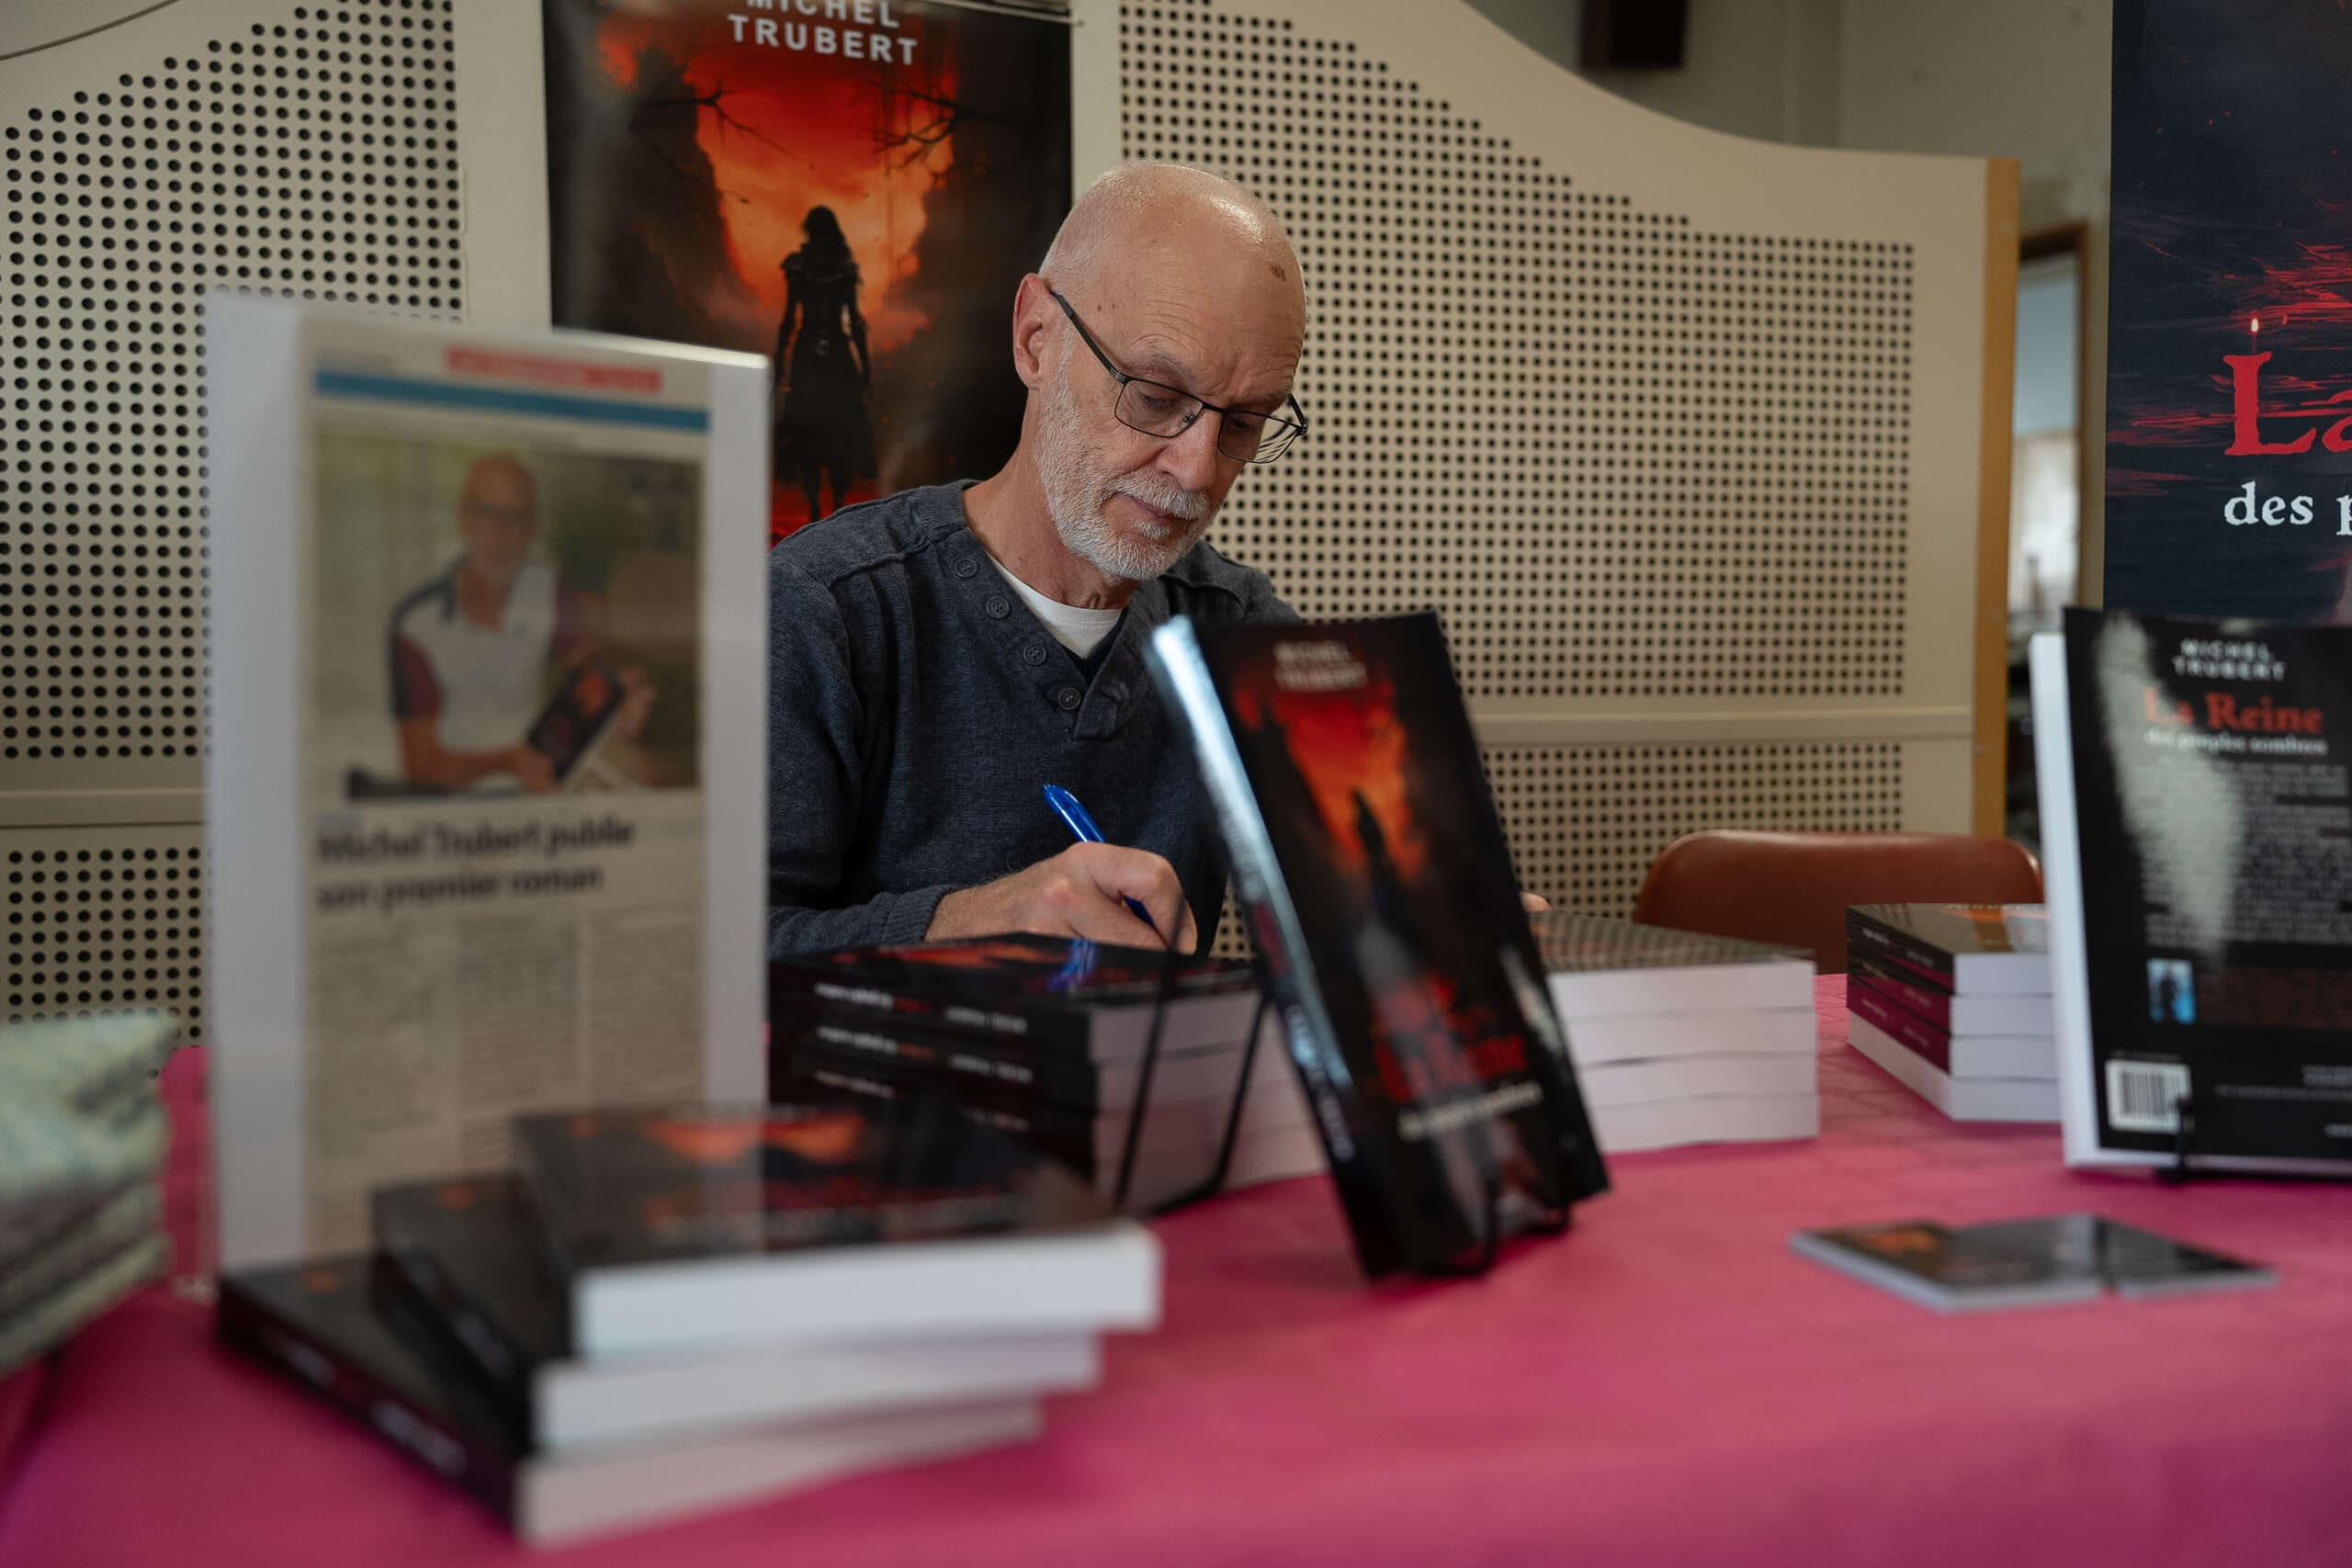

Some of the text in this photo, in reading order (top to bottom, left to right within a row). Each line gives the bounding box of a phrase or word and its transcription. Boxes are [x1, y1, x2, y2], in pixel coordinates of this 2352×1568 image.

[728, 14, 918, 65] TRUBERT
[2223, 480, 2313, 525] des
[2173, 655, 2286, 682] TRUBERT
[2180, 638, 2273, 661] MICHEL
[2205, 691, 2324, 733] Reine
